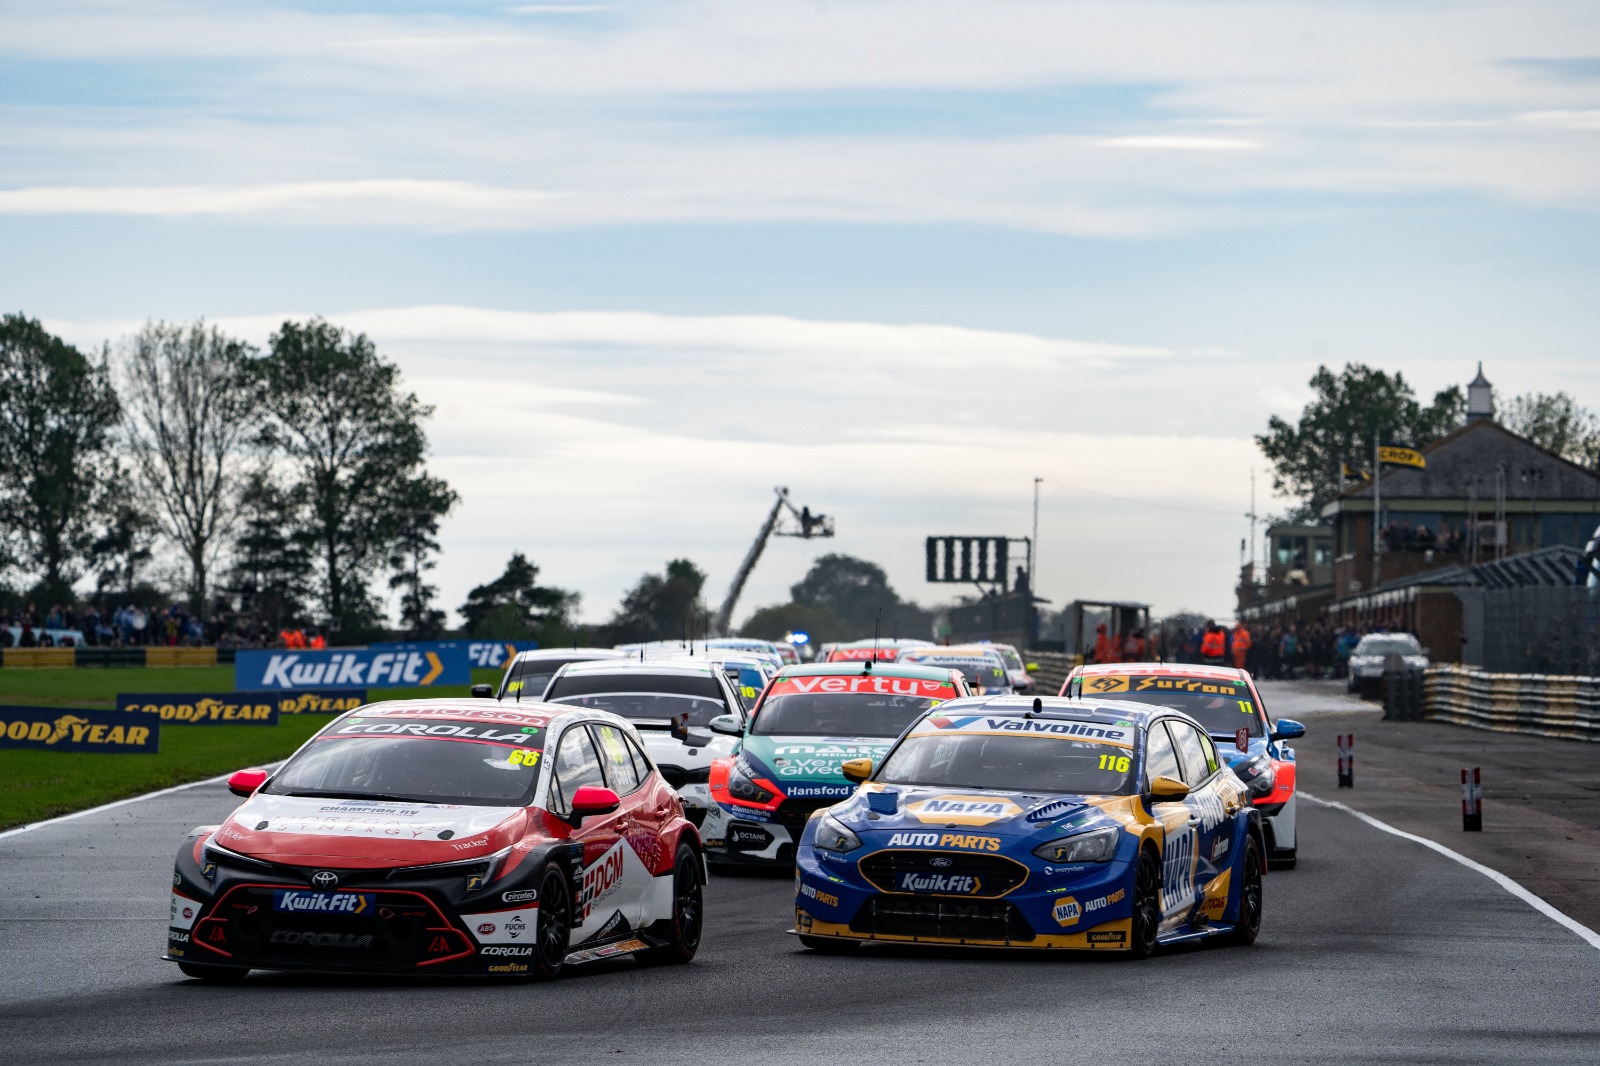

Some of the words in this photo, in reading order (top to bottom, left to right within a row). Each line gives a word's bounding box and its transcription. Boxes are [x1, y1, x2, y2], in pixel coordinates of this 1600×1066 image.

[934, 656, 995, 665] Valvoline
[740, 686, 756, 698] 16
[1238, 701, 1253, 714] 11
[337, 723, 533, 743] COROLLA
[987, 719, 1125, 740] Valvoline
[509, 749, 540, 767] 66
[1099, 754, 1130, 773] 116
[787, 786, 849, 796] Hansford
[732, 805, 771, 817] Diamondbrite
[922, 800, 1005, 815] NAPA
[277, 823, 424, 838] SYNERGY
[1060, 822, 1075, 830] THE
[452, 838, 488, 851] Tracker
[887, 833, 939, 847] AUTO
[939, 834, 1001, 851] PARTS
[594, 845, 623, 898] DCM
[507, 891, 533, 900] zircotec
[801, 883, 816, 899] AUTO
[816, 890, 839, 908] PARTS
[1085, 897, 1107, 913] AUTO
[1107, 888, 1125, 905] PARTS
[1056, 903, 1079, 919] NAPA
[479, 923, 494, 934] ABS
[505, 923, 526, 931] FUCHS
[270, 929, 374, 948] COROLLA
[481, 946, 533, 956] COROLLA
[488, 962, 528, 973] GOODYEAR
